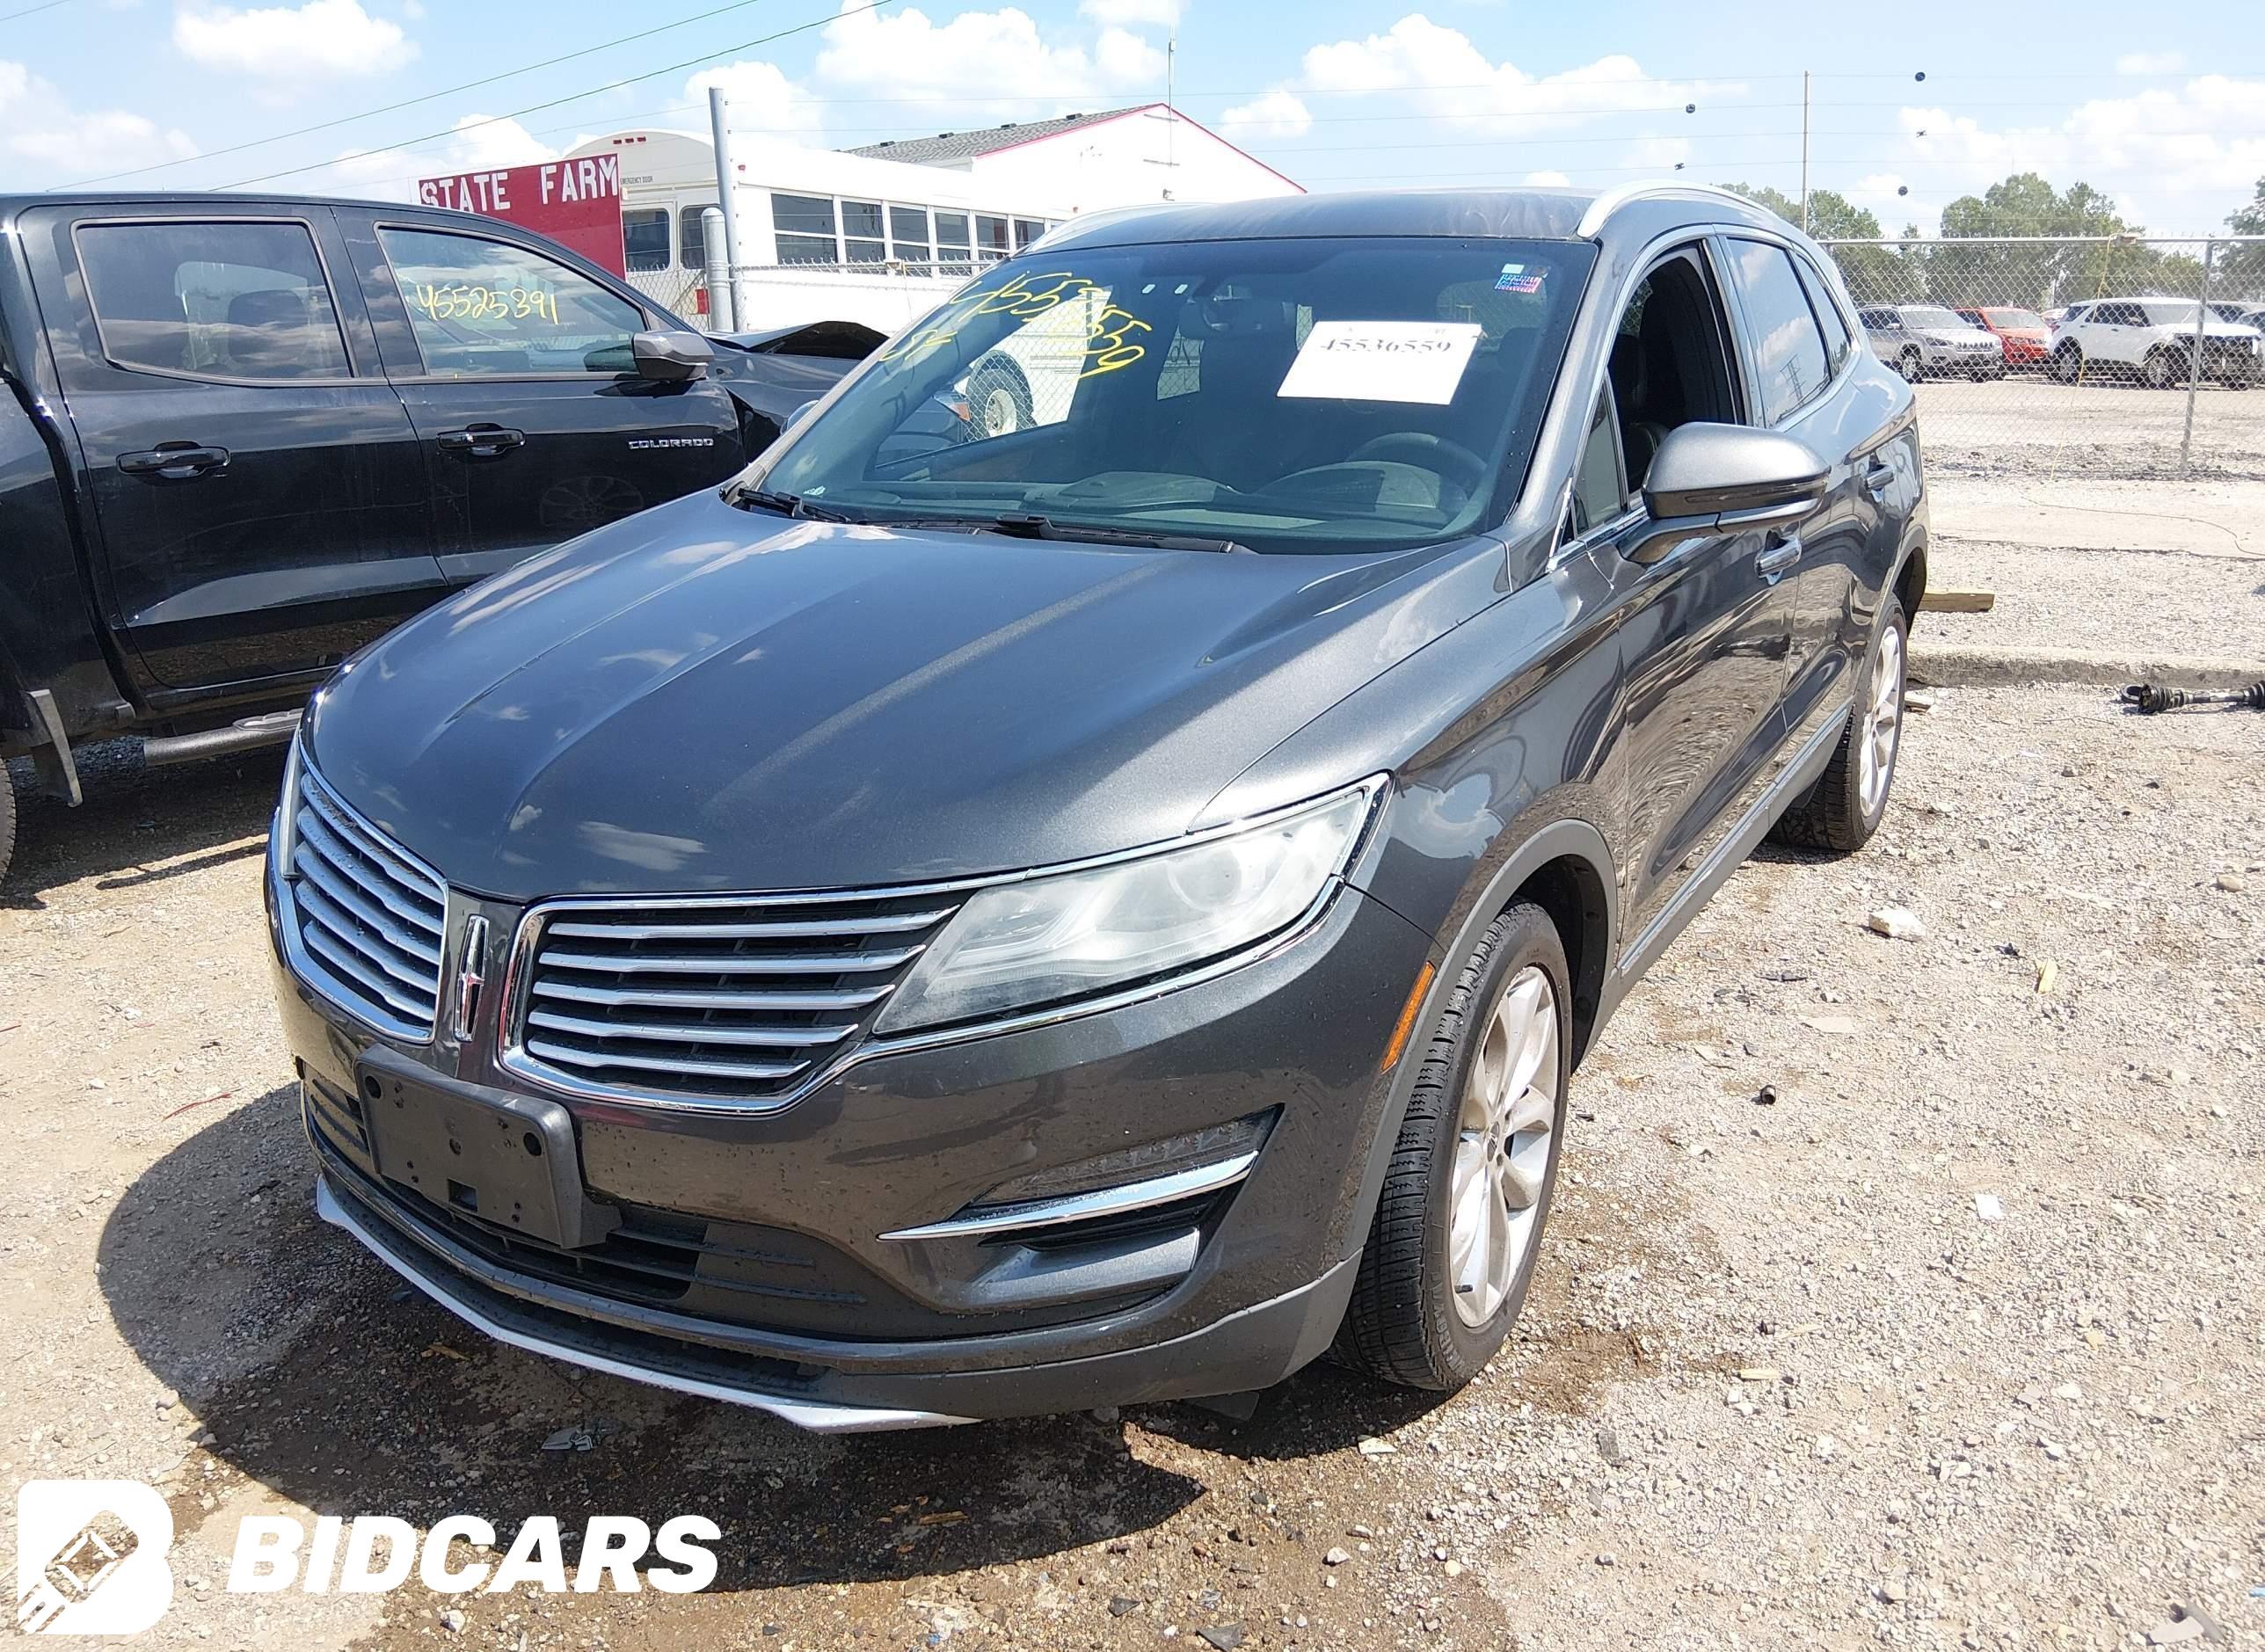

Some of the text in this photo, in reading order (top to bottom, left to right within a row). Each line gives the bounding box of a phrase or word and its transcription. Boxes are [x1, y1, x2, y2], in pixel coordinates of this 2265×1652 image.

[420, 156, 618, 212] STATE FARM
[416, 285, 558, 324] 45525391
[1321, 338, 1452, 353] 45536559
[628, 438, 714, 450] COLORADO
